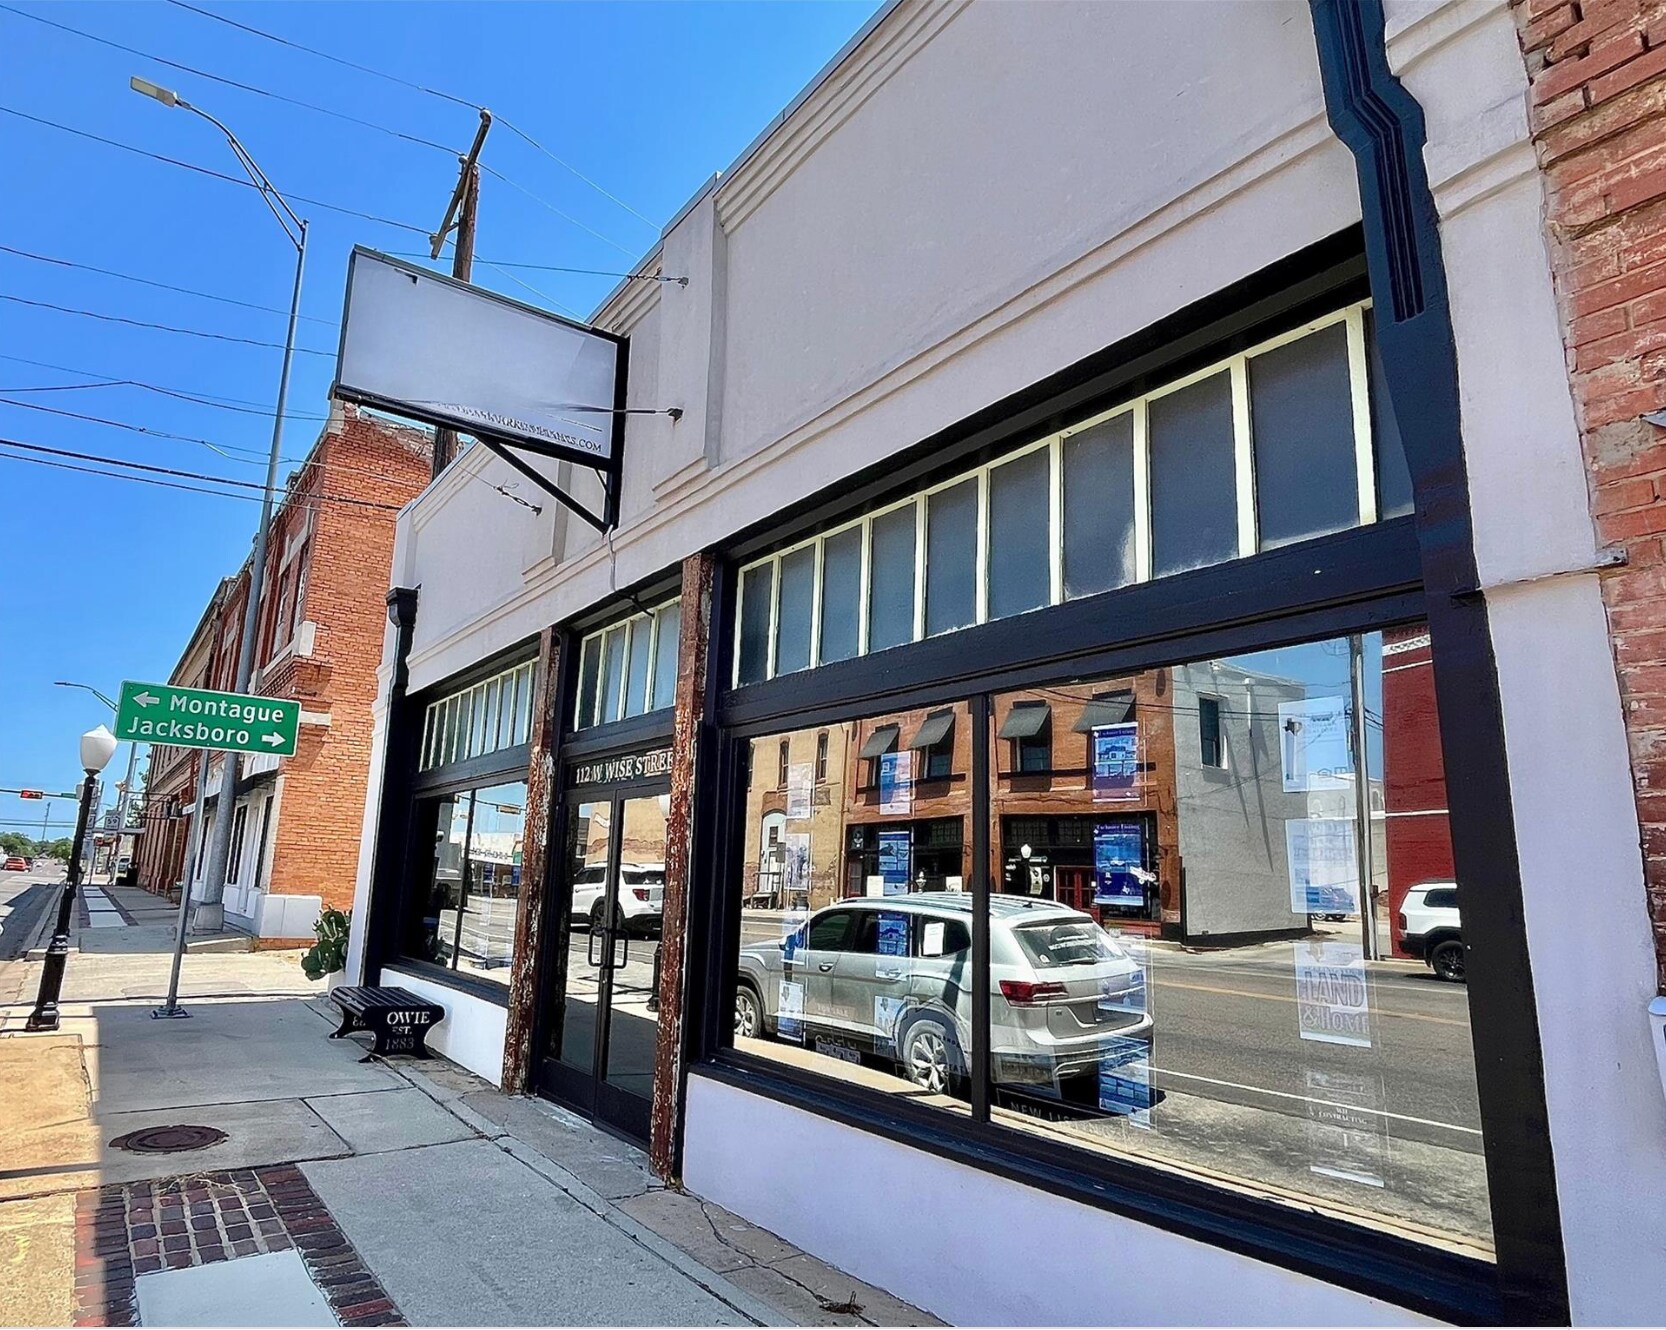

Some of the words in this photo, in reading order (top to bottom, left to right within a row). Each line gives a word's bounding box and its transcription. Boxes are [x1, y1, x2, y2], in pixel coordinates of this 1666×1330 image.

[170, 694, 284, 723] Montague
[127, 717, 249, 744] Jacksboro
[576, 766, 591, 783] 112
[605, 759, 633, 779] WISE
[635, 751, 674, 775] STREE
[1304, 970, 1364, 1007] LAND
[1303, 1006, 1317, 1027] &
[386, 1038, 414, 1050] 1883
[1010, 1101, 1042, 1117] NEW
